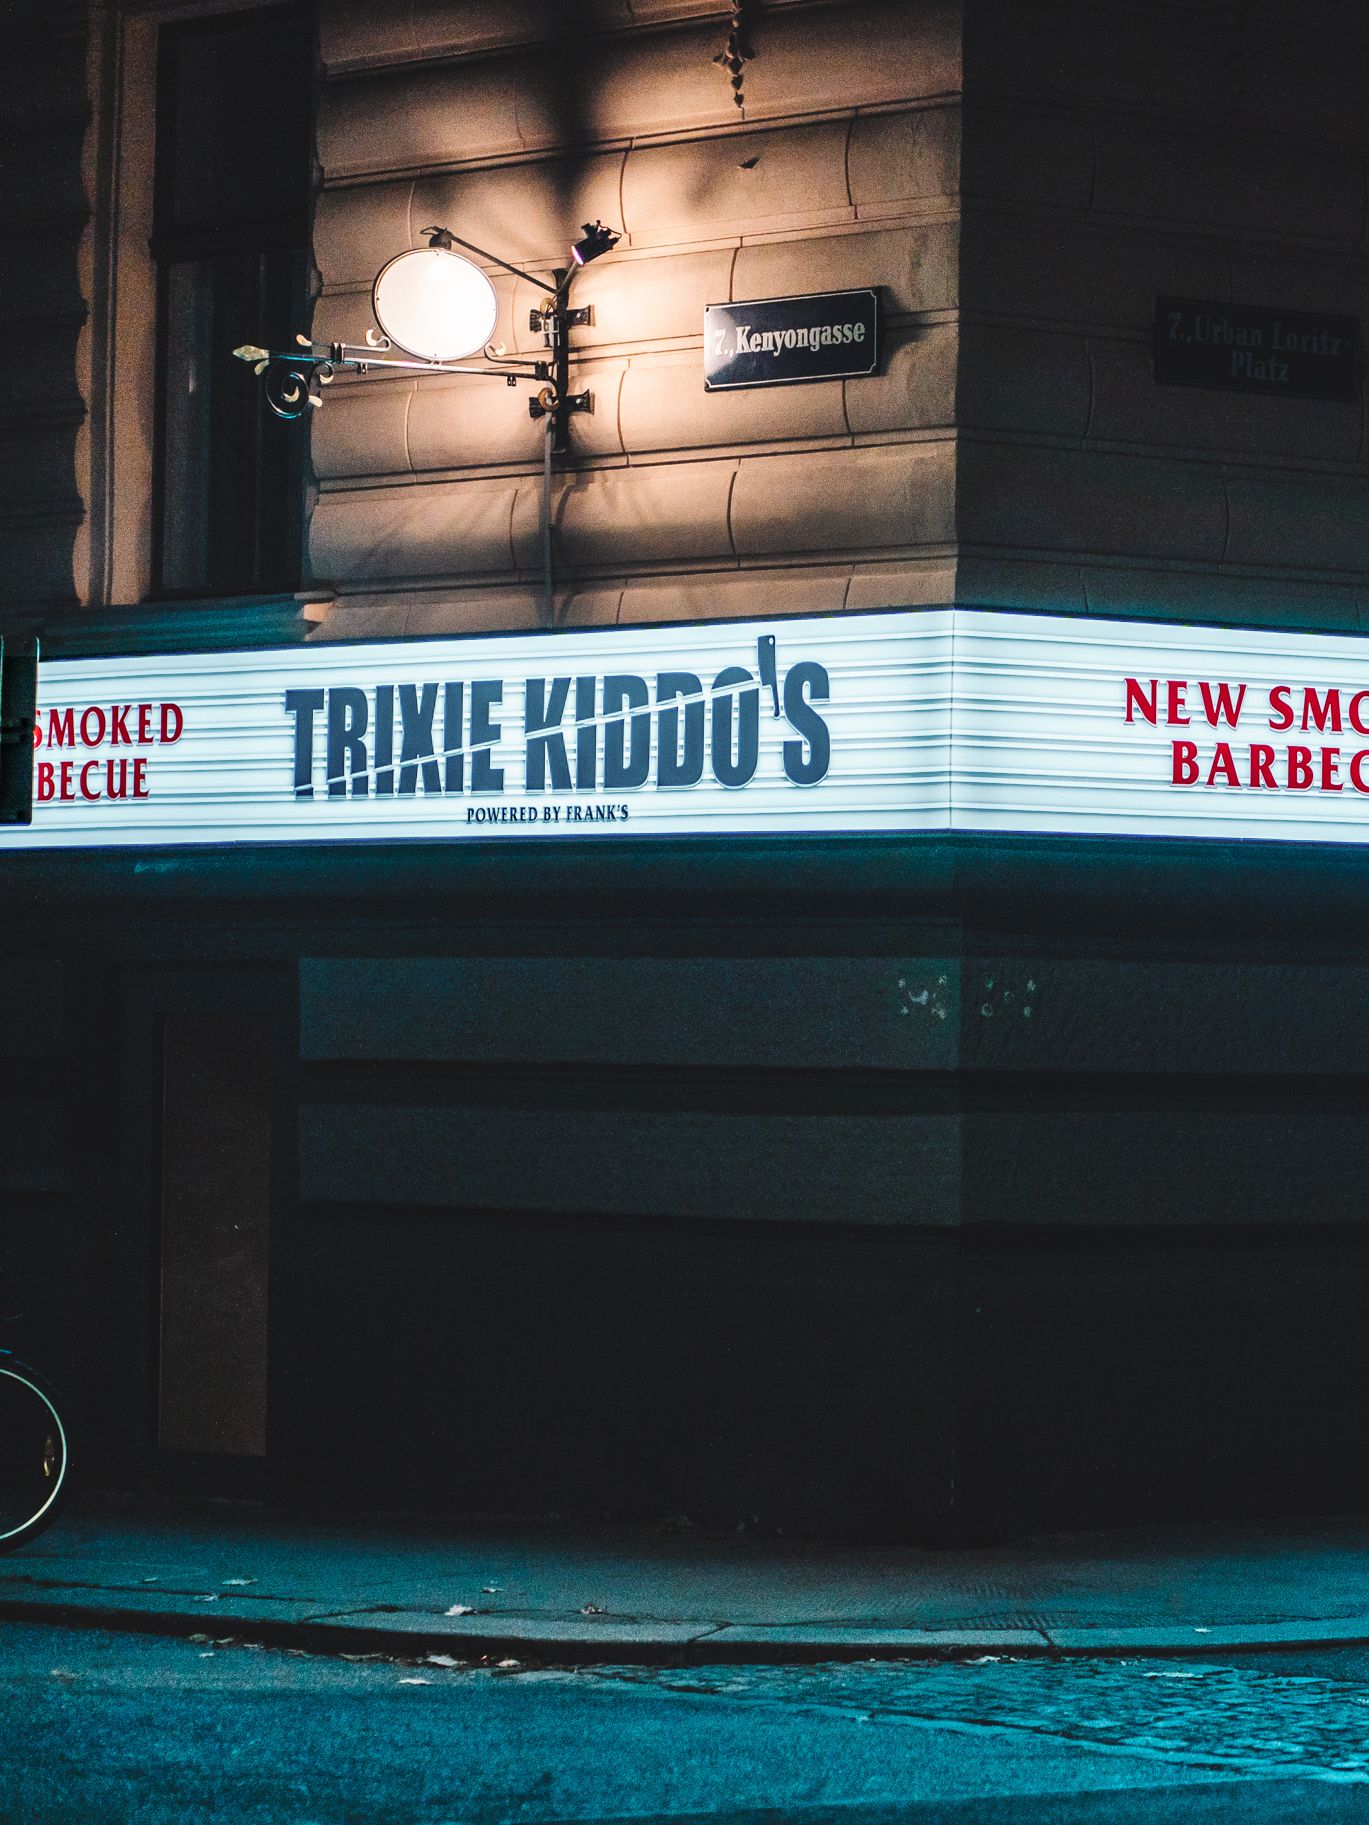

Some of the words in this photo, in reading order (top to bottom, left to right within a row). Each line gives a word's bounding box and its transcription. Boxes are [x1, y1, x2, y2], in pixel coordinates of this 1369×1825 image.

[1230, 348, 1290, 383] Platz
[284, 679, 505, 799] TRIXIE
[524, 634, 832, 792] KIDDO'S
[1125, 677, 1247, 728] NEW
[466, 806, 538, 823] POWERED
[543, 805, 561, 822] BY
[566, 804, 629, 822] FRANK'S
